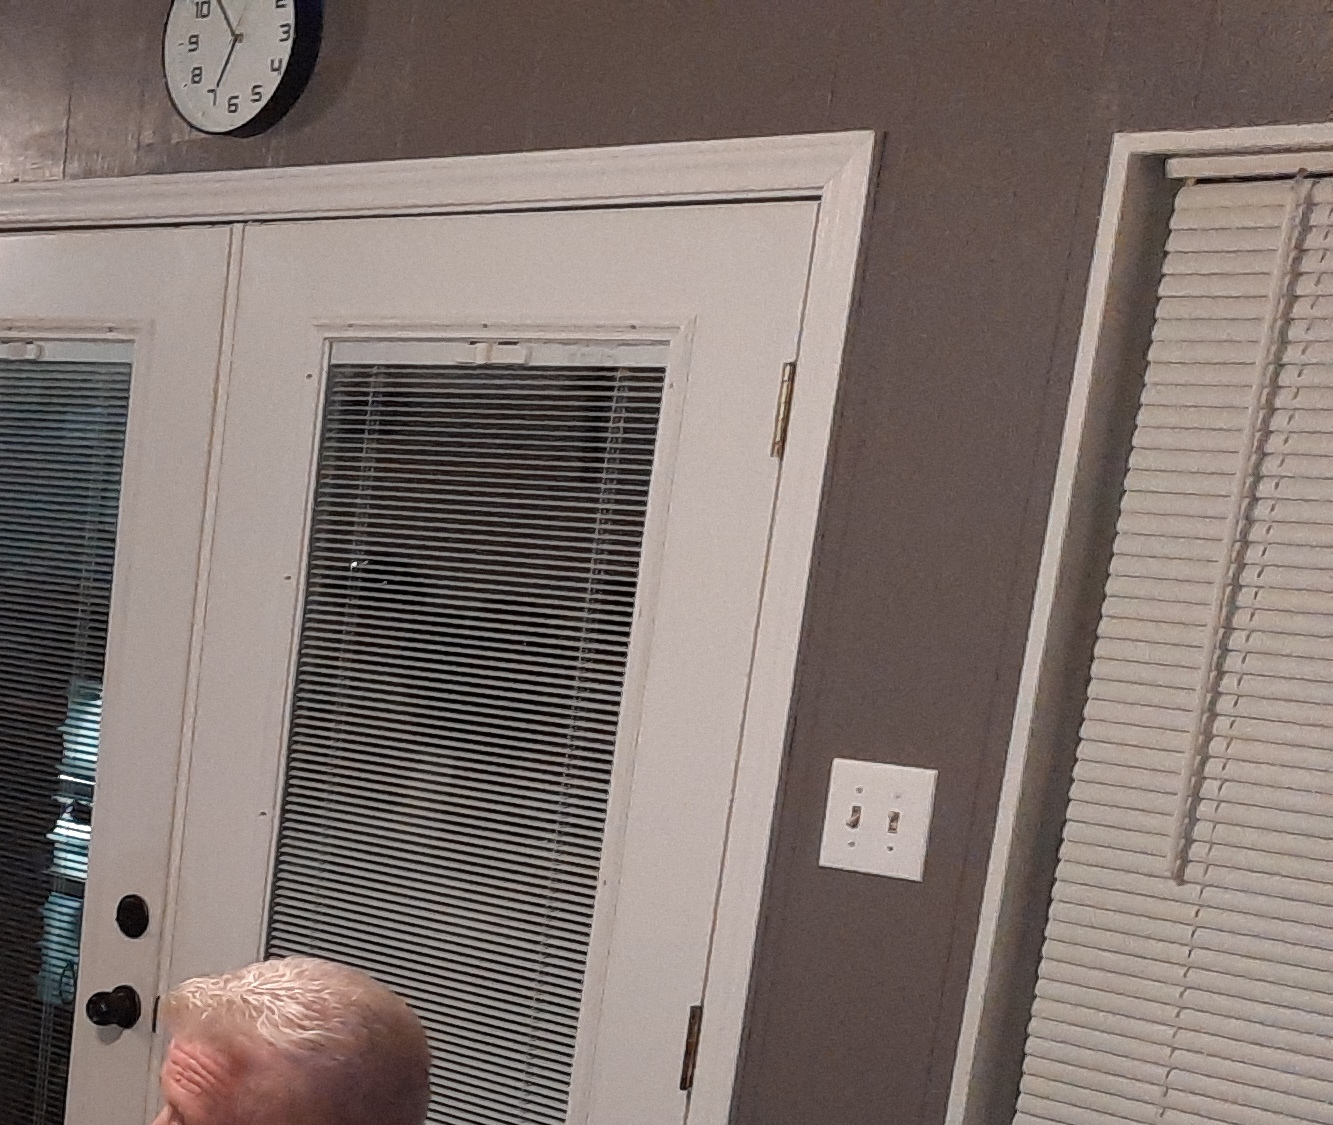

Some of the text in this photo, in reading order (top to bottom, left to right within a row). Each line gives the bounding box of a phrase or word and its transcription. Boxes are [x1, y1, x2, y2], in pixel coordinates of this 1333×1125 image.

[195, 0, 210, 19] 10
[279, 23, 291, 42] 3
[188, 34, 199, 53] 9
[190, 66, 203, 85] 8
[270, 58, 282, 75] 4
[207, 88, 218, 107] 7
[250, 85, 263, 103] 5
[227, 95, 239, 114] 6
